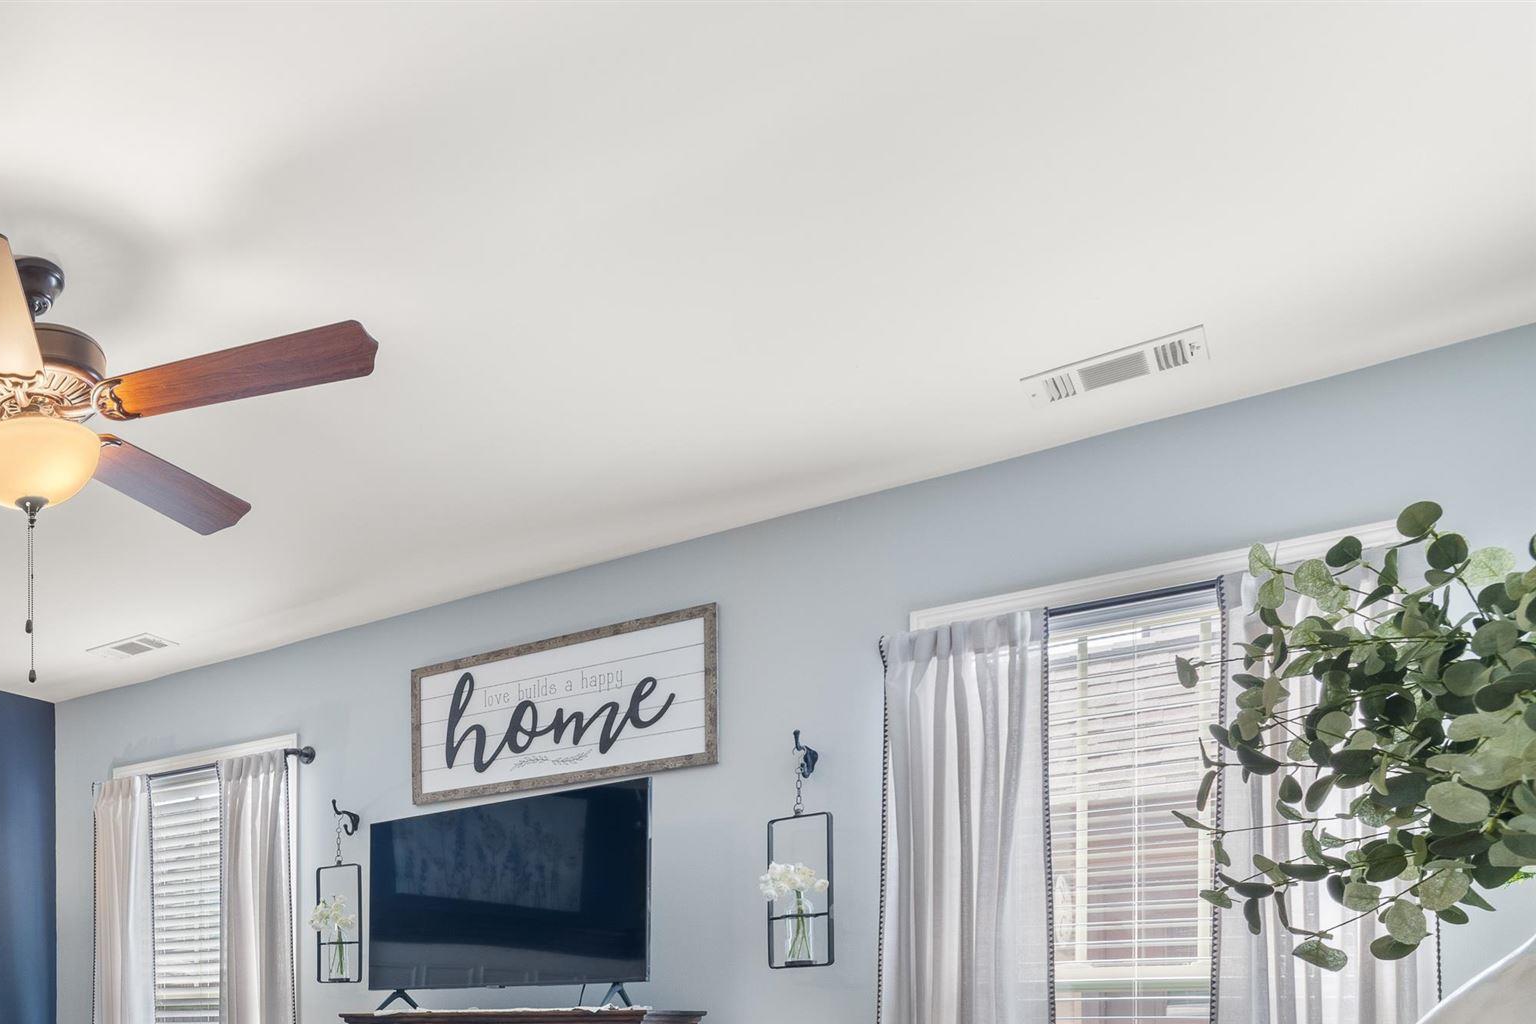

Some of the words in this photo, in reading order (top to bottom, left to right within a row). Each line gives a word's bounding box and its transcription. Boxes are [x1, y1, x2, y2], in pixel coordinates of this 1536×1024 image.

[445, 672, 675, 773] home
[484, 689, 510, 708] love
[518, 677, 557, 701] builds
[564, 679, 573, 692] a
[581, 669, 623, 693] happy
